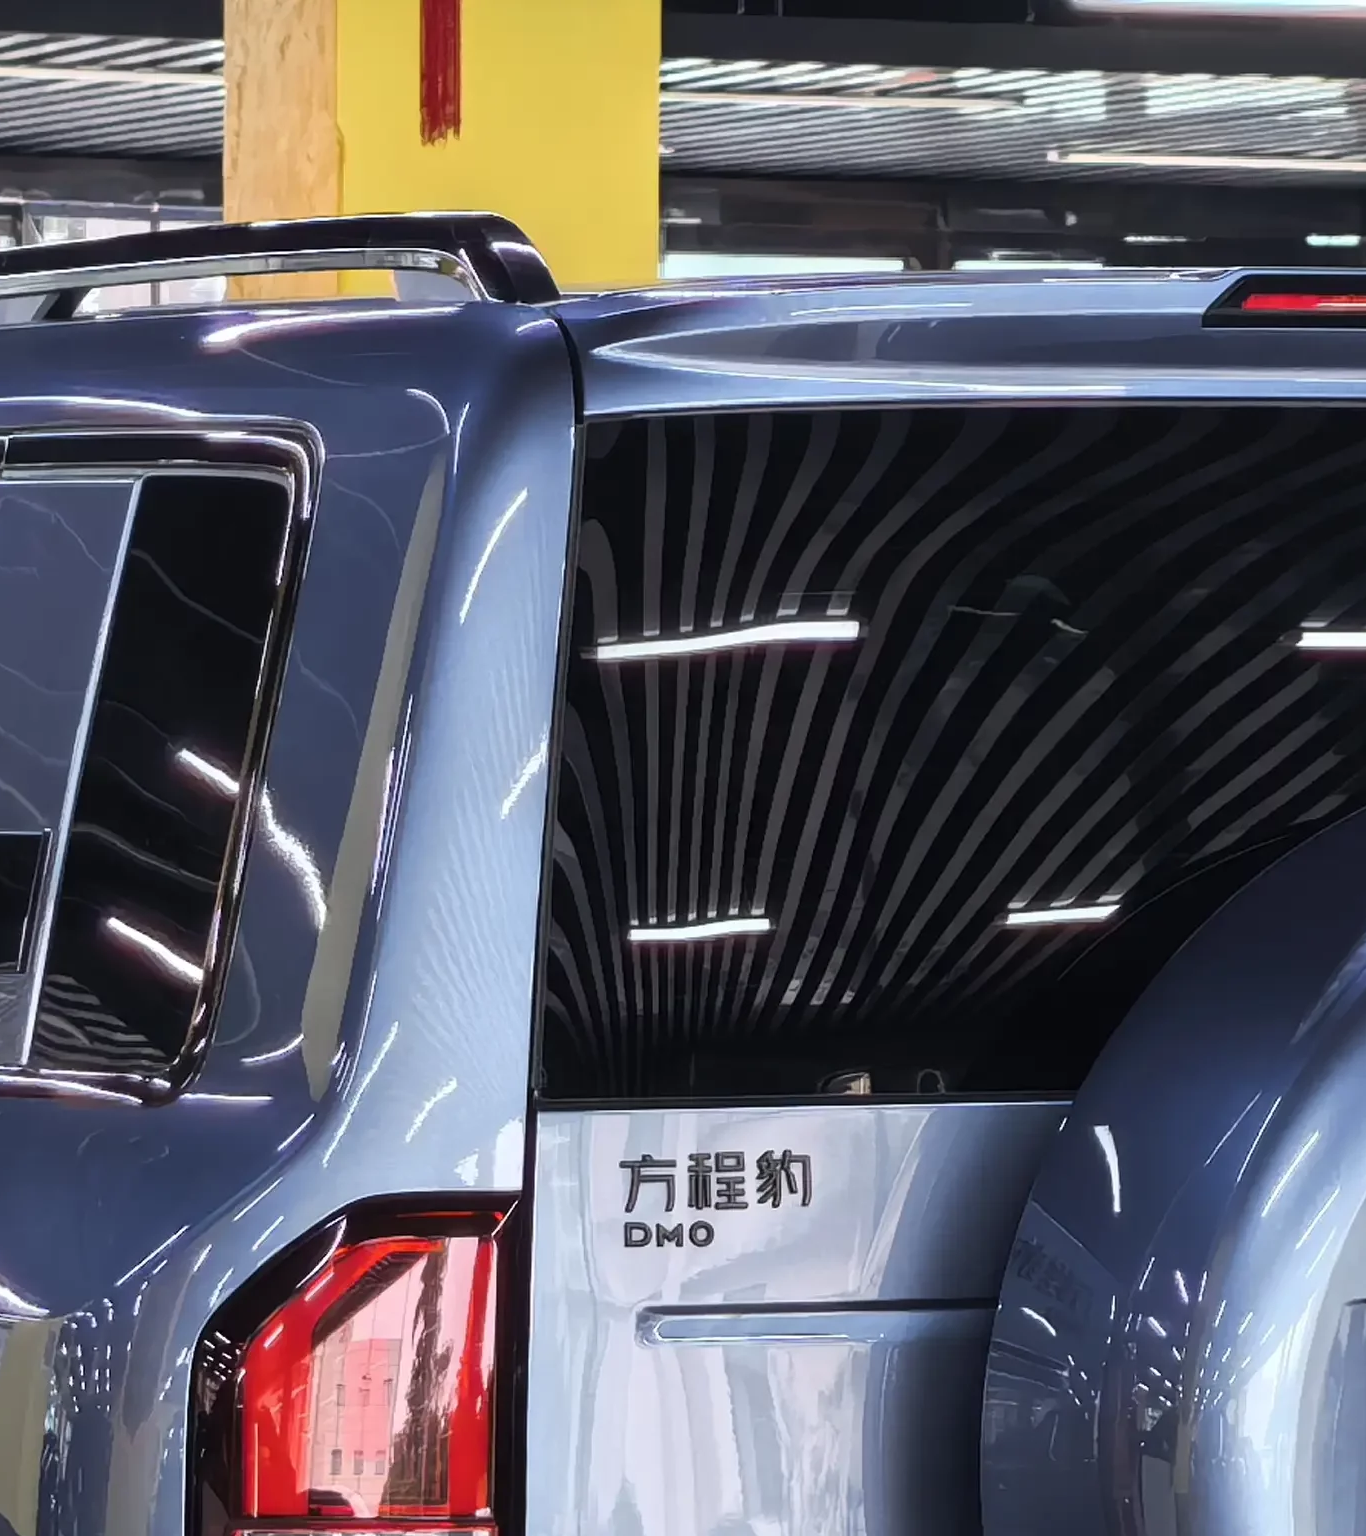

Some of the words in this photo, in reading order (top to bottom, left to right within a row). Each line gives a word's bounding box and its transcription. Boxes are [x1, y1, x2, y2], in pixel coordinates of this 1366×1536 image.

[619, 1148, 813, 1214] 方程豹
[623, 1220, 715, 1248] DMO
